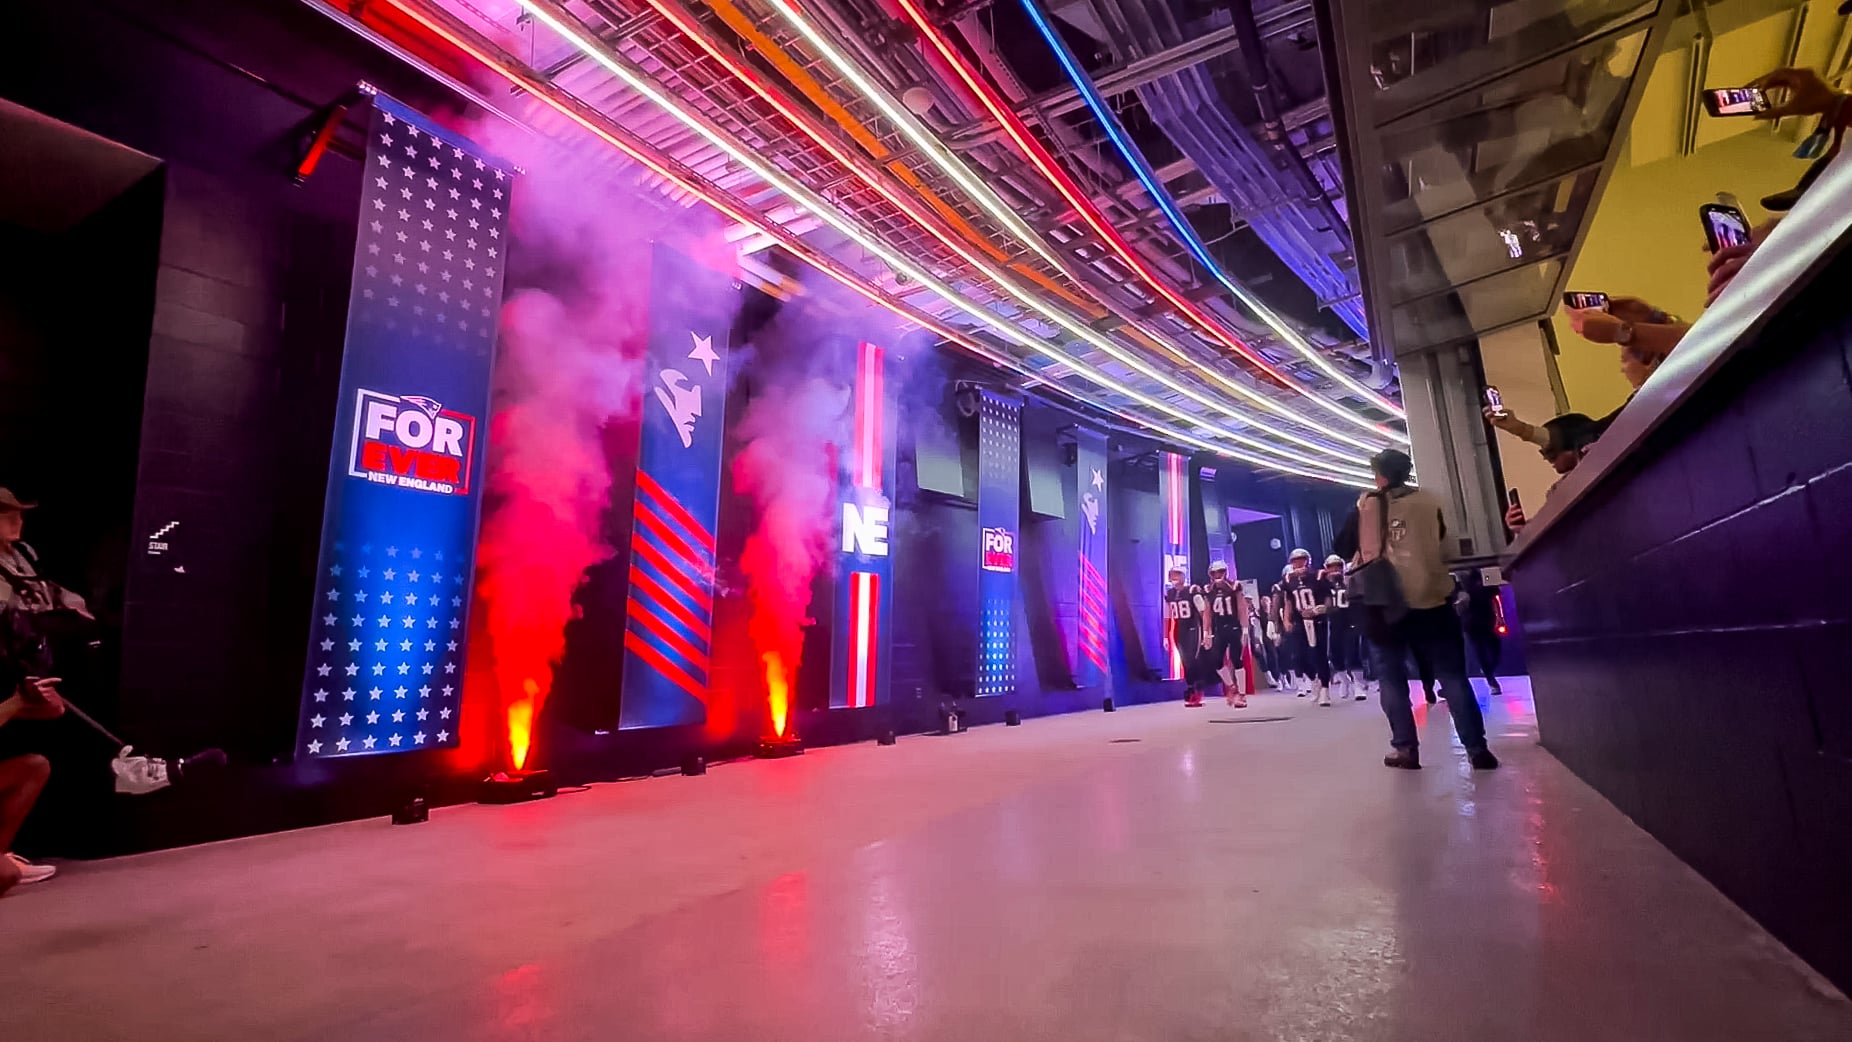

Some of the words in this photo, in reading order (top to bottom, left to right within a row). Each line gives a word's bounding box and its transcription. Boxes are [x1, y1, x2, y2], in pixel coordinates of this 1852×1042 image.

[365, 401, 463, 457] FOR
[362, 440, 461, 484] EVER
[368, 471, 398, 486] NEW
[398, 476, 453, 494] ENGLAND
[842, 502, 889, 556] NE
[985, 532, 1013, 554] FOR
[1212, 596, 1233, 616] 41
[1292, 588, 1316, 611] 10
